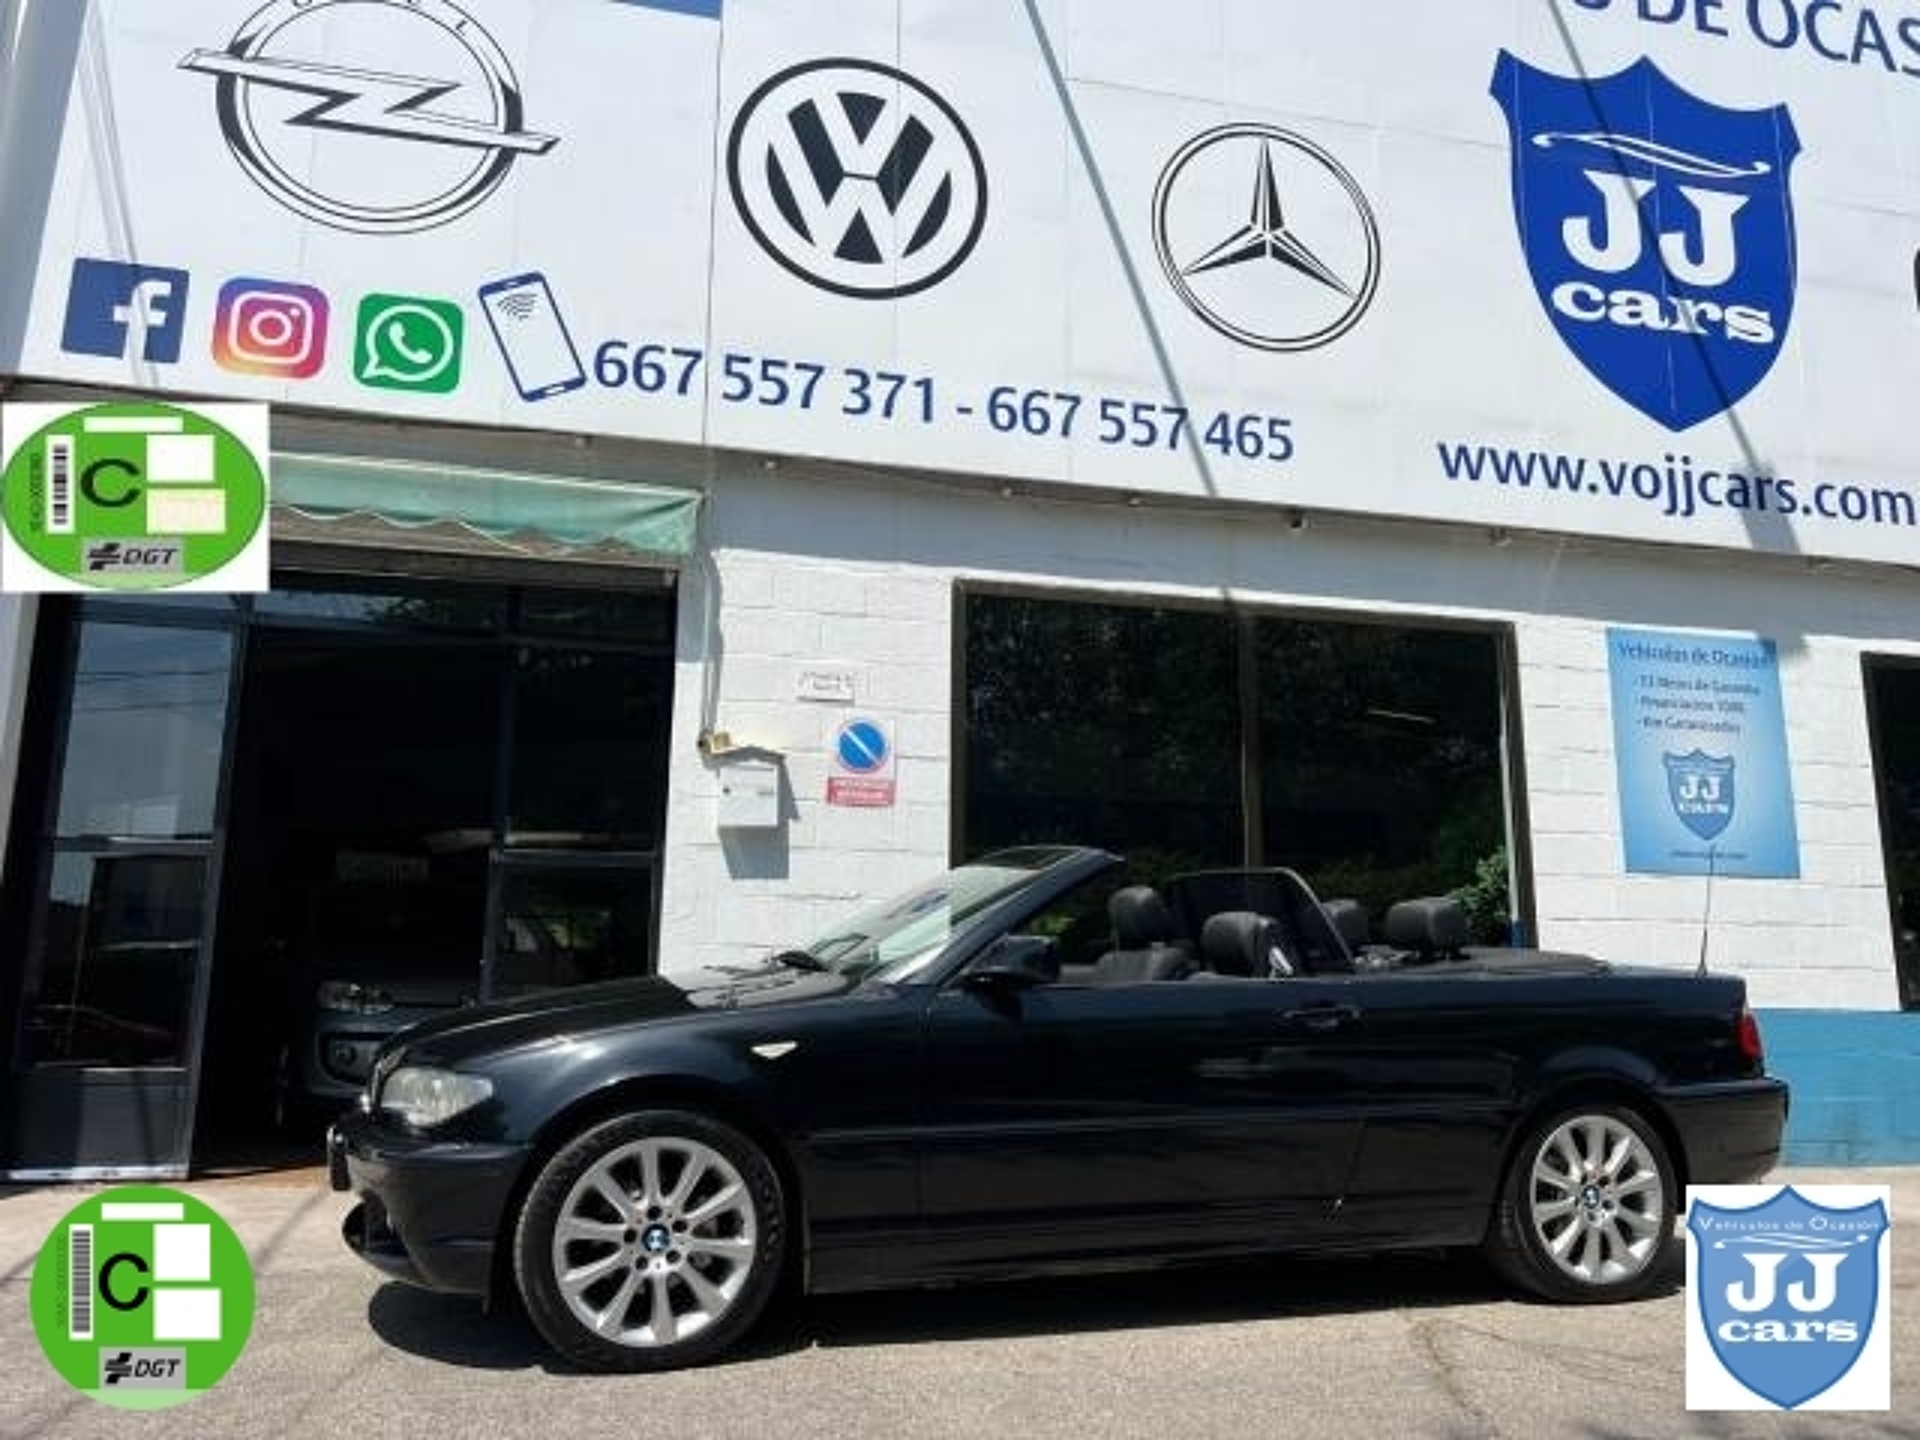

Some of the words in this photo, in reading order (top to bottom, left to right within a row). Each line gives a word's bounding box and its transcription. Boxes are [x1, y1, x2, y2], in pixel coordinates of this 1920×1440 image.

[1552, 281, 1775, 344] cars
[593, 340, 704, 396] 667
[721, 353, 826, 409] 557
[842, 367, 935, 424] 371
[987, 386, 1081, 438] 667
[1099, 398, 1190, 450] 557
[1204, 412, 1294, 462] 465
[1438, 441, 1916, 526] www.vojjcars.com
